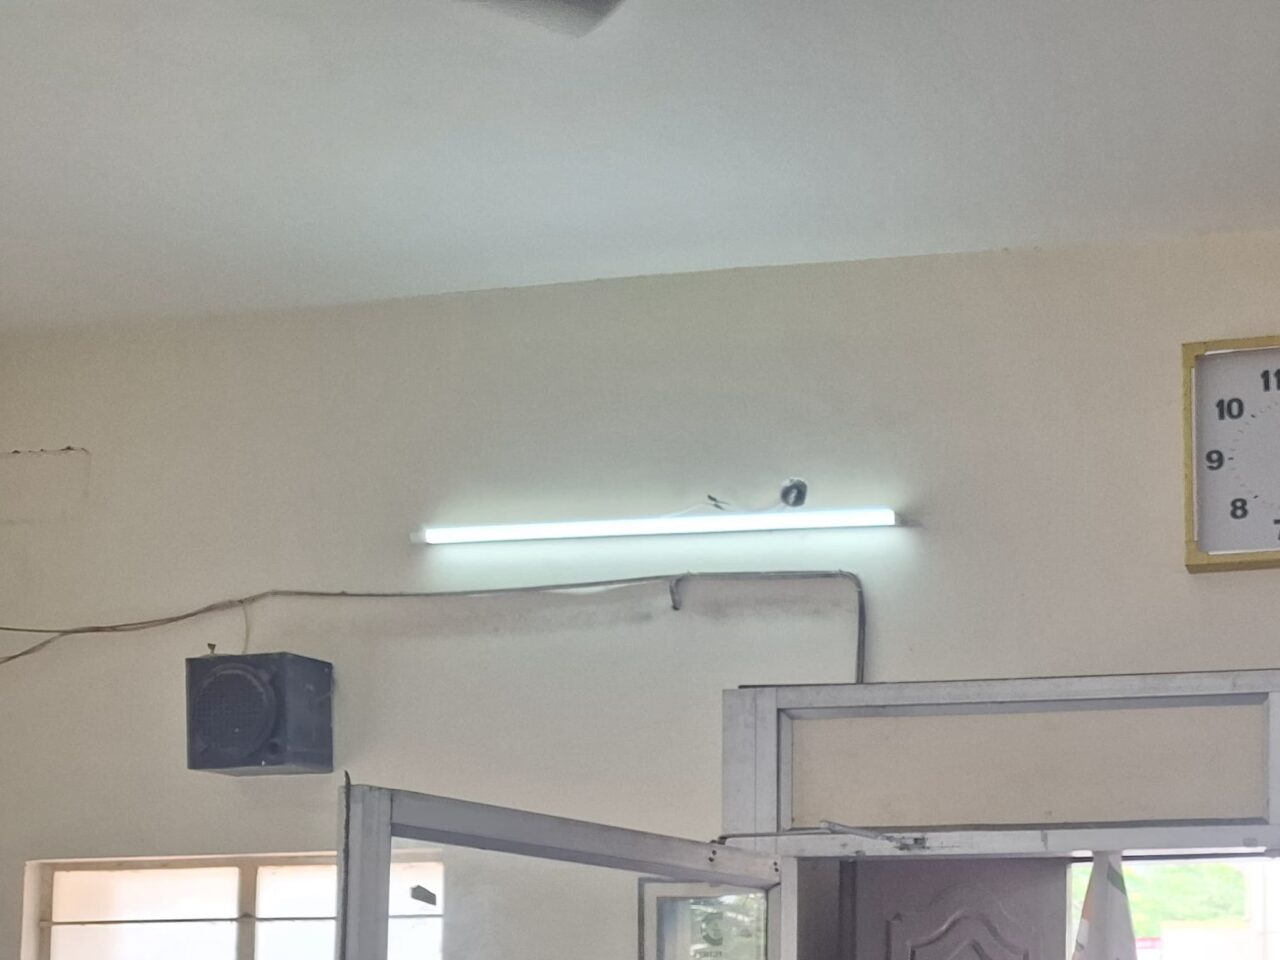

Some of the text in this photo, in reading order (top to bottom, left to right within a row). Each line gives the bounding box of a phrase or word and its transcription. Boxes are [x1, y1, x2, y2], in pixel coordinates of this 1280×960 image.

[1215, 398, 1244, 421] 10
[1205, 449, 1224, 470] 9
[1230, 498, 1248, 519] 8
